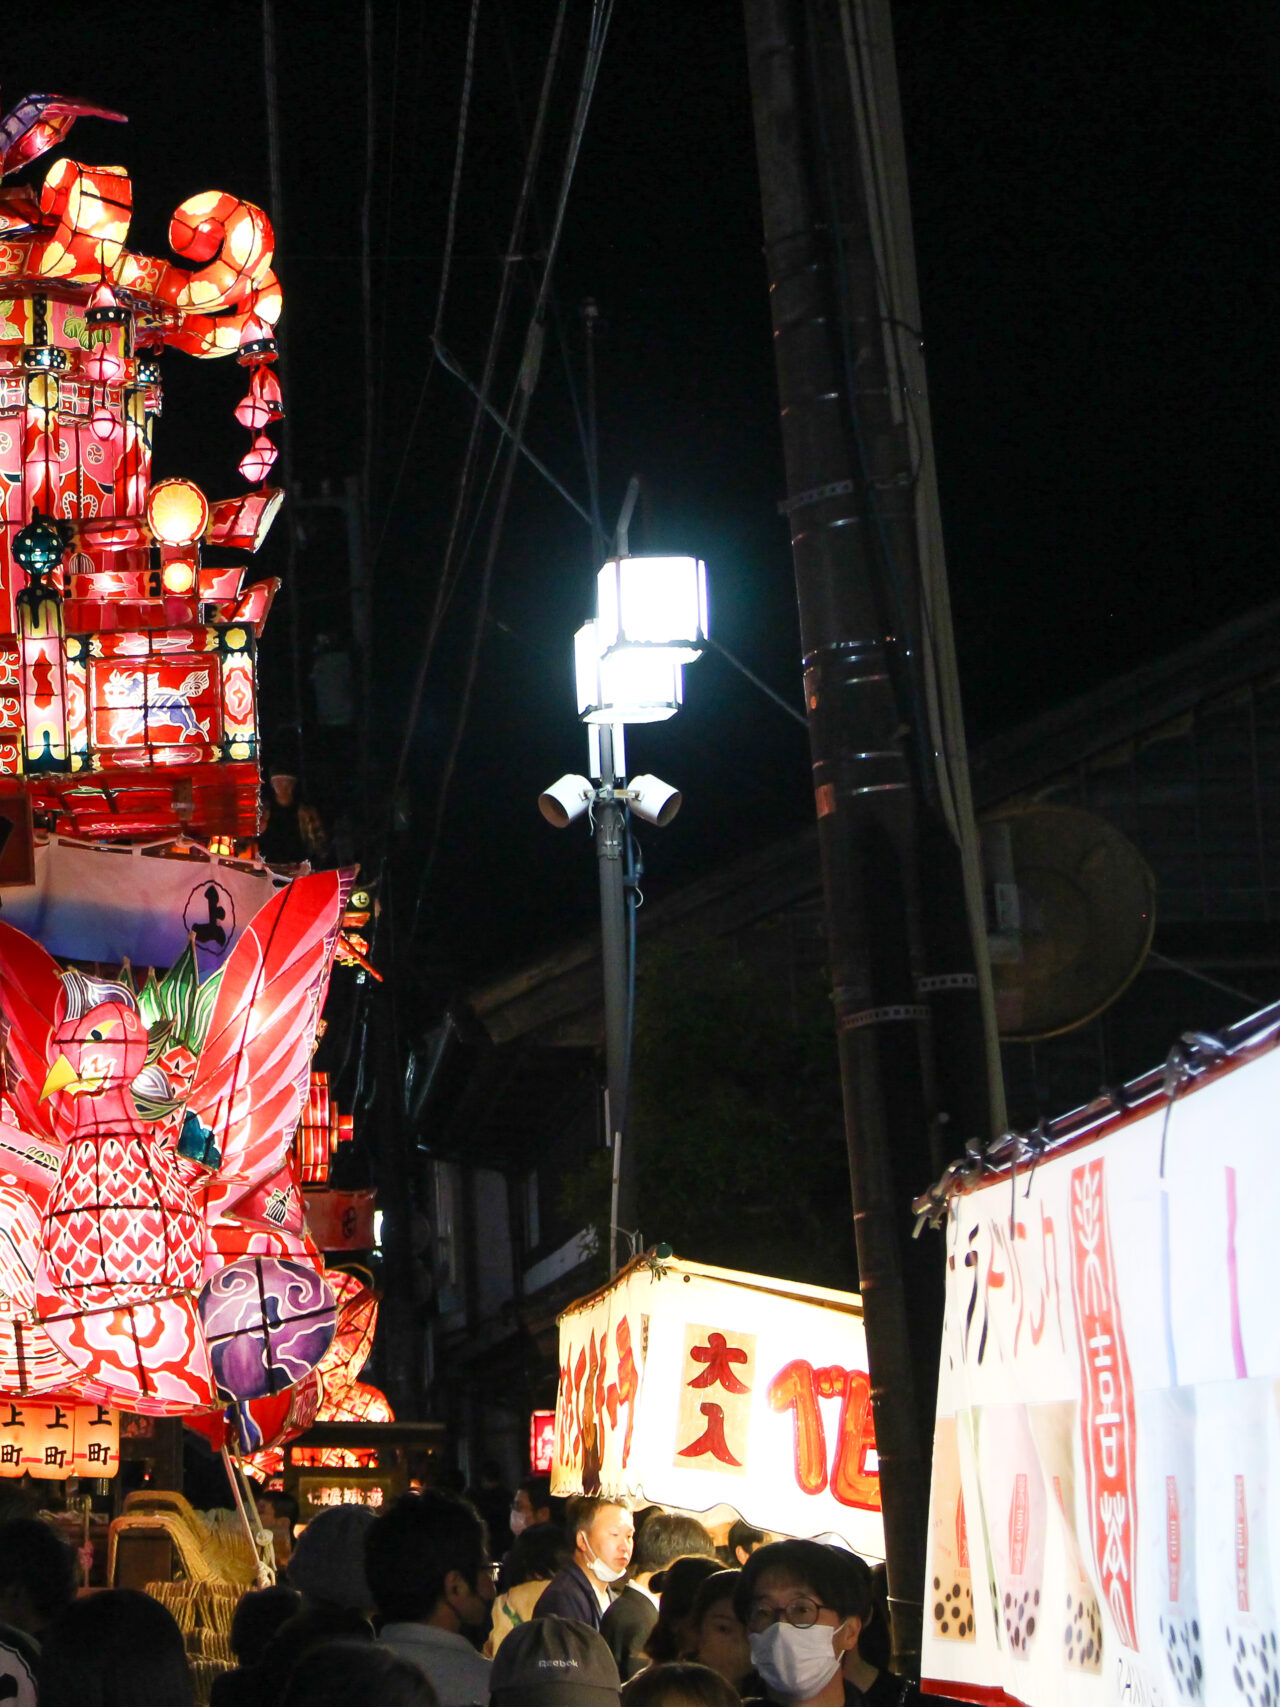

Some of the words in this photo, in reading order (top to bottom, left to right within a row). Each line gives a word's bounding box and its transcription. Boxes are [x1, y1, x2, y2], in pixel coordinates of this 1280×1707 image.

[675, 1331, 752, 1468] 大入
[1, 1403, 25, 1467] 上町
[45, 1405, 69, 1469] 上町
[88, 1404, 112, 1464] 上町
